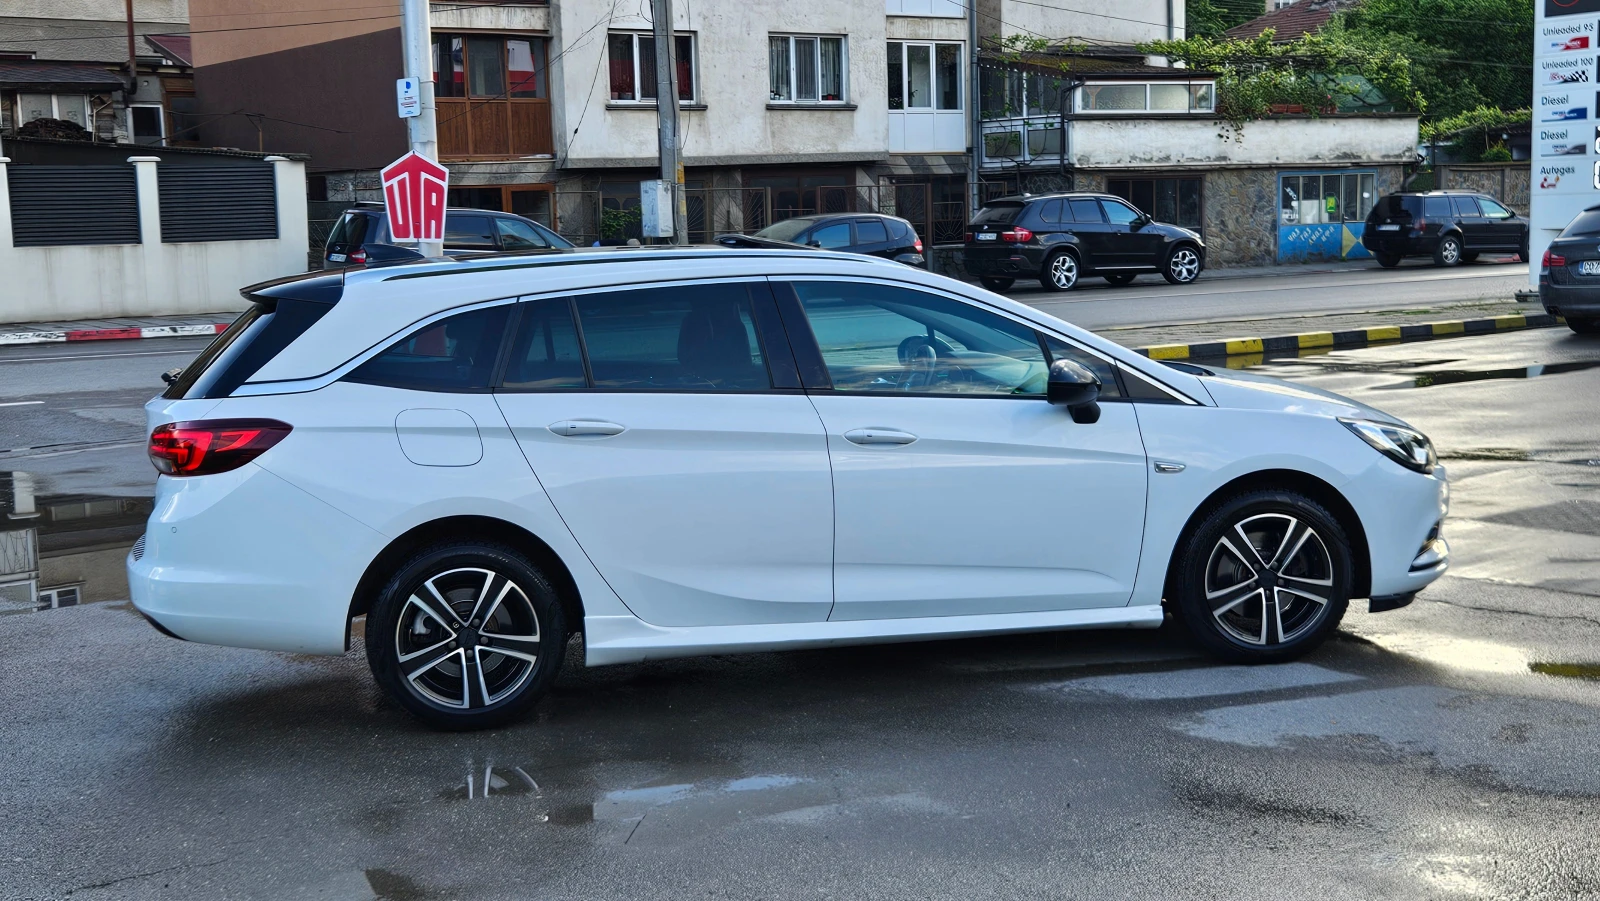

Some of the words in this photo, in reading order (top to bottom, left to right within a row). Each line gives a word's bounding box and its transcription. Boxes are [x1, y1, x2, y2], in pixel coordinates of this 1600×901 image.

[1542, 24, 1580, 36] Unleaded
[1541, 58, 1578, 70] Unleaded
[1580, 57, 1594, 66] 100
[1541, 95, 1569, 106] Diesel
[1540, 129, 1568, 140] Diesel
[1540, 166, 1575, 176] Autogas
[383, 154, 447, 239] UTA
